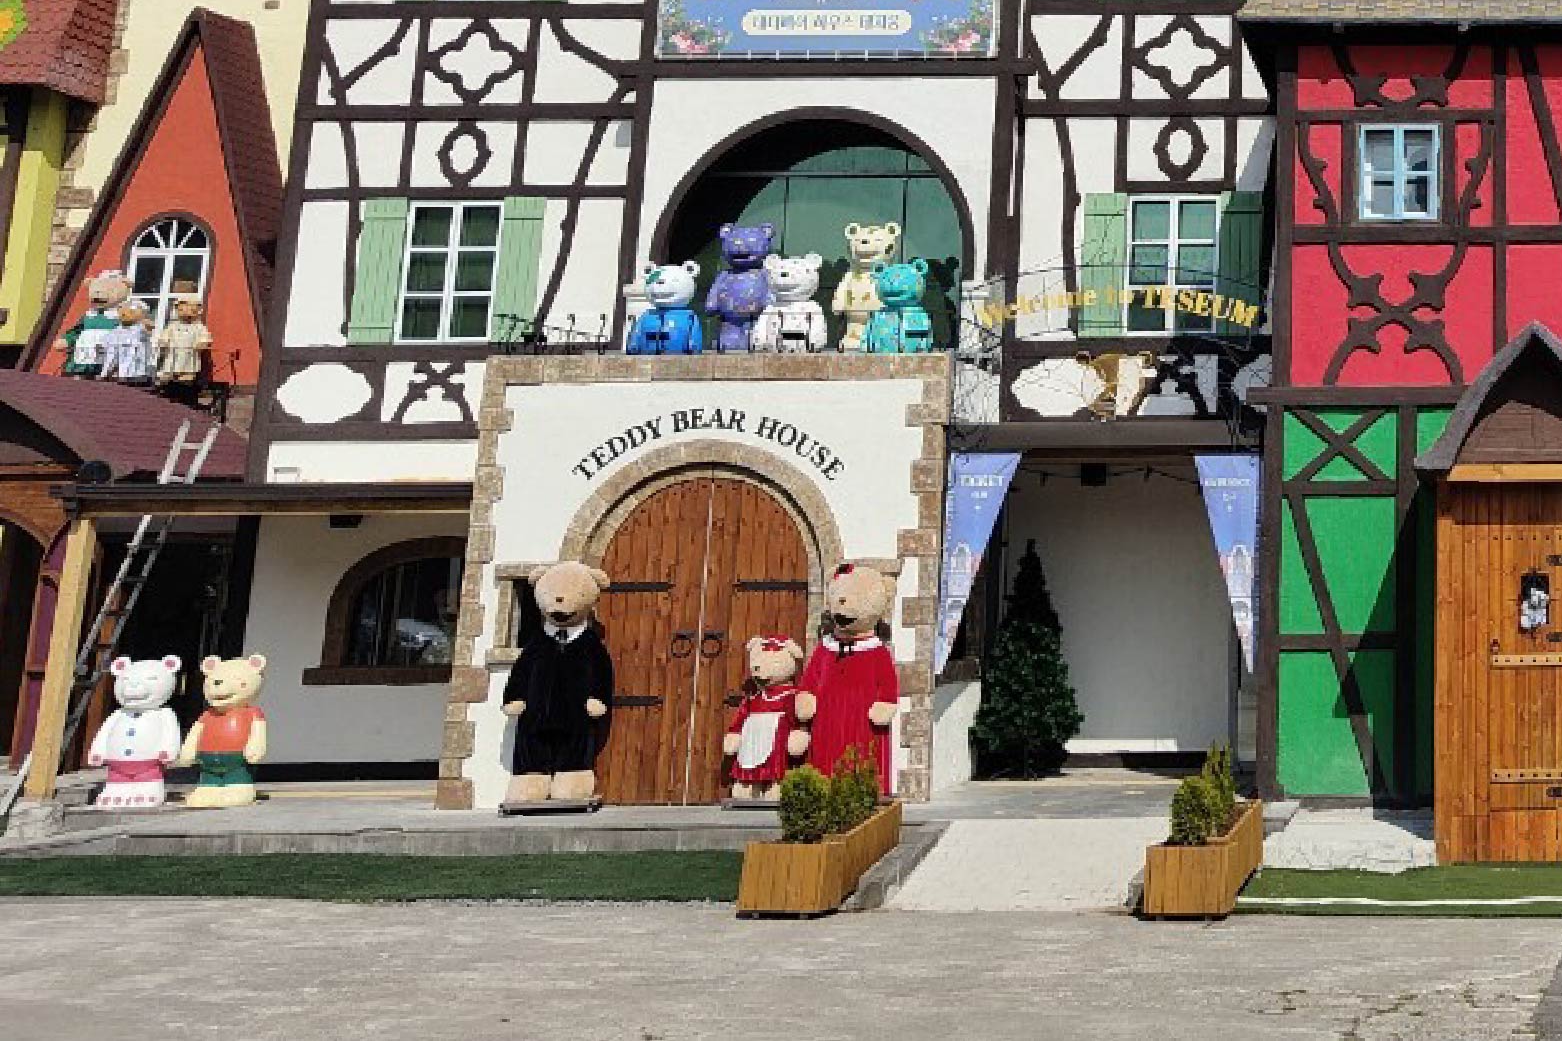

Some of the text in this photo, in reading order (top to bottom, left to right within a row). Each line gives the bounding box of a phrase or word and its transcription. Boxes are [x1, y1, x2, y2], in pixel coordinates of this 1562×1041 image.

[975, 285, 1260, 329] Welcome to TESEUM
[572, 407, 845, 482] TEDDY BEAR HOUSE
